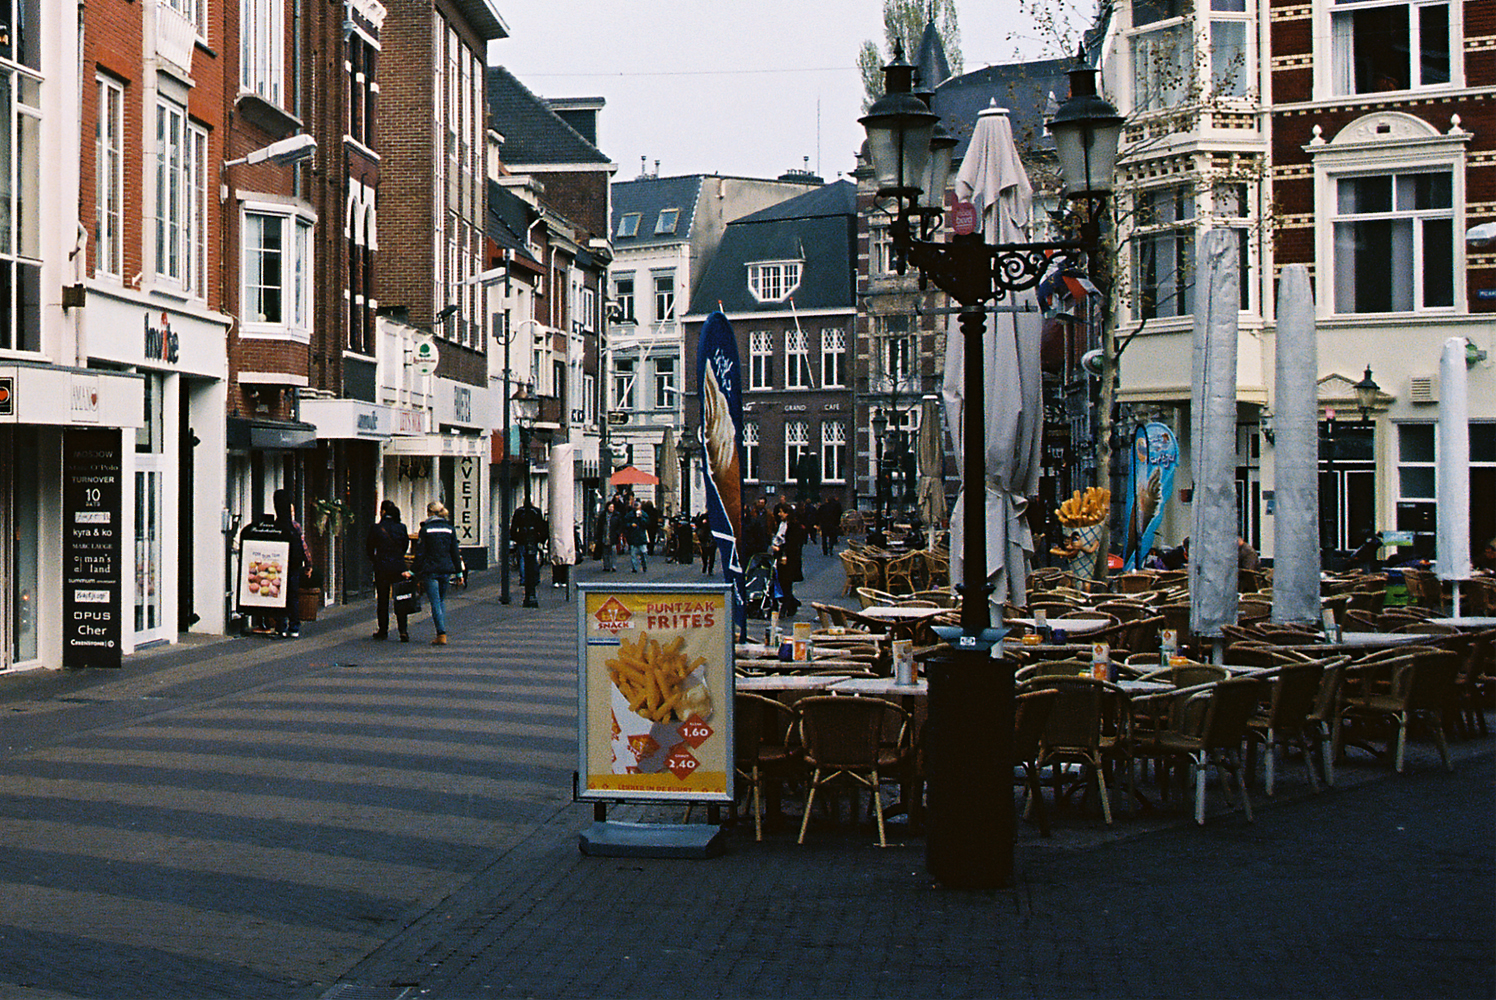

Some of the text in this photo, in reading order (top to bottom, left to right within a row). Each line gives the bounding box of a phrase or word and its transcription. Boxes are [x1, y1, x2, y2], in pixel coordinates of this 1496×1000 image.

[144, 312, 179, 364] Invite
[784, 404, 807, 412] GRAND
[85, 488, 101, 502] 10
[73, 528, 113, 538] kyra & ko
[84, 553, 111, 563] man's
[90, 564, 111, 573] land
[646, 601, 715, 614] PUNTZAK
[73, 611, 111, 621] OPUS
[598, 621, 630, 630] SNACK
[647, 613, 715, 630] FRITES
[77, 624, 108, 636] Cher
[683, 727, 709, 738] 1,60
[668, 759, 696, 769] 2,40
